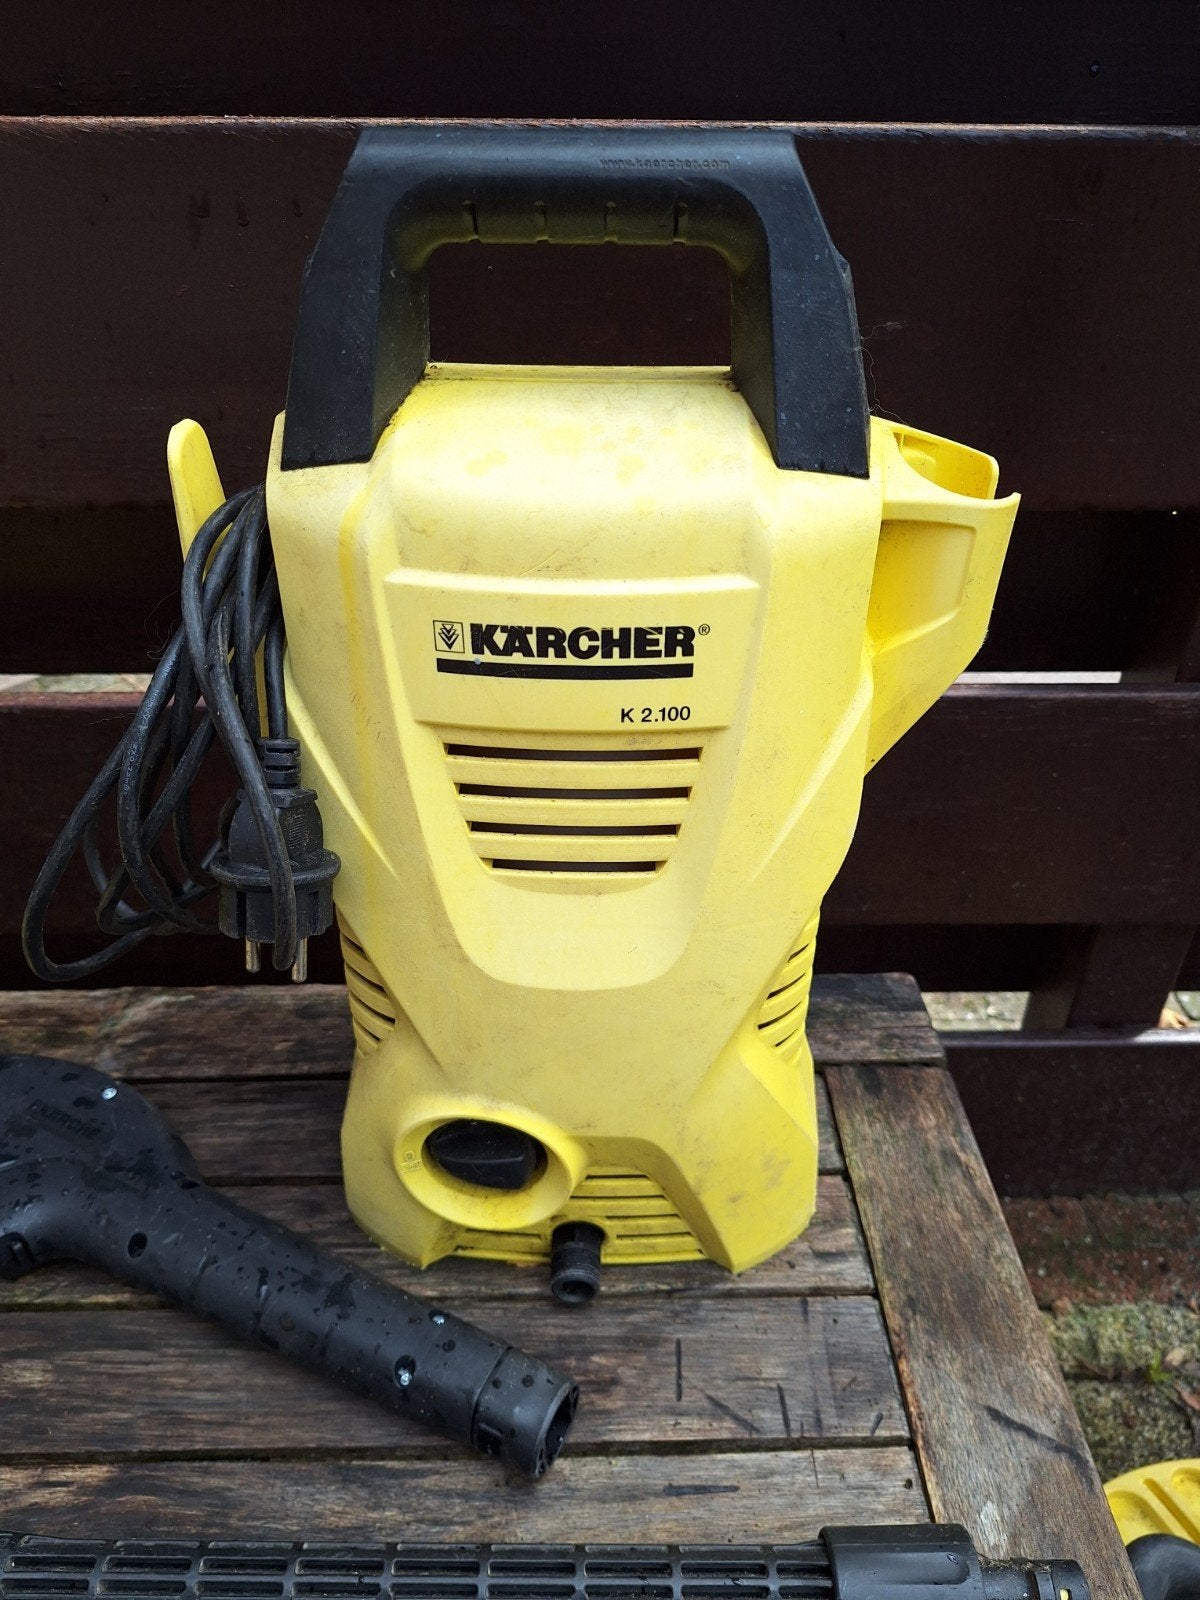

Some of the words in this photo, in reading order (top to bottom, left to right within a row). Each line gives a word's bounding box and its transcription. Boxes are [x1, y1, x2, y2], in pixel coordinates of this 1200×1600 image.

[600, 158, 730, 169] www.kaercher.com
[620, 707, 634, 723] K
[641, 706, 691, 722] 2.100
